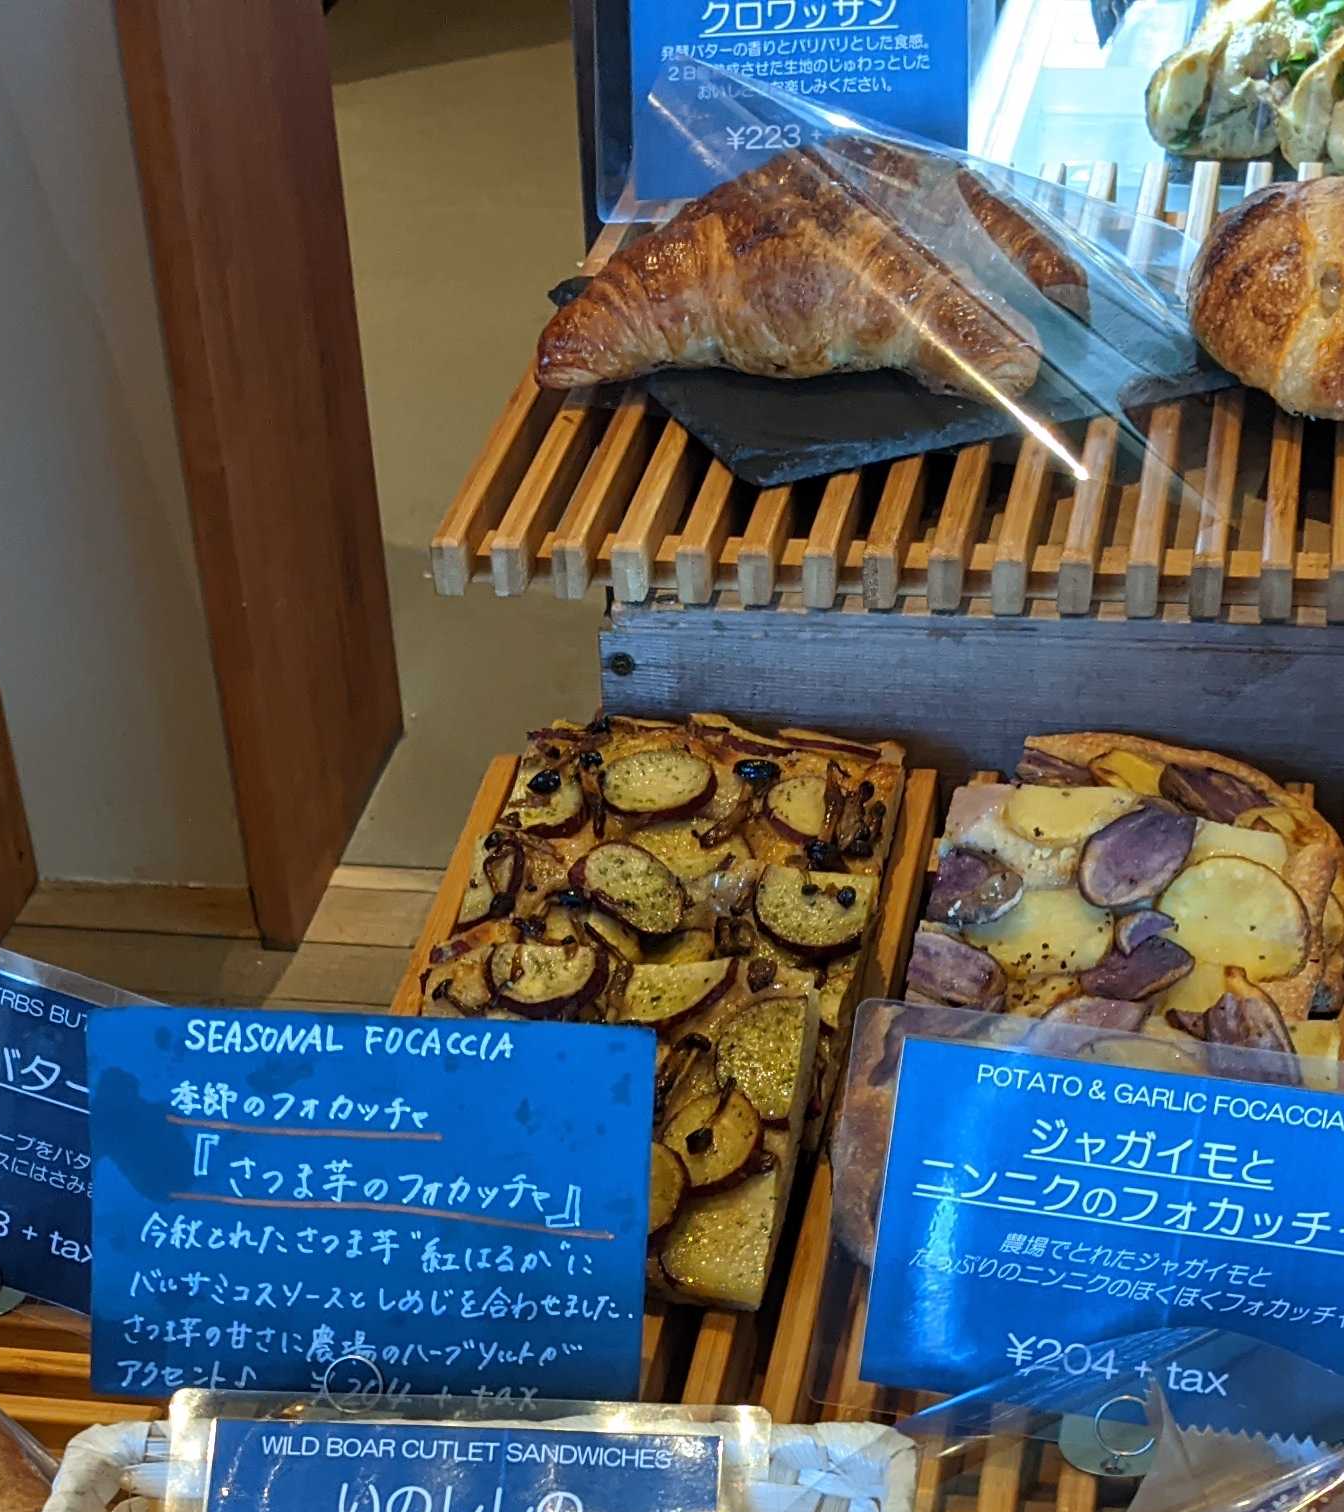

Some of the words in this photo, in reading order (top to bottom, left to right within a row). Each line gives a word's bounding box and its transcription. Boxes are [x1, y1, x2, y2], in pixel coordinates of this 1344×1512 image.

[726, 124, 801, 150] ¥223
[184, 1019, 344, 1053] SEASONAL
[364, 1025, 516, 1061] FOCACCIA
[169, 1079, 430, 1130] 季節のフォカッチャ
[976, 1061, 1083, 1100] POTATO
[1088, 1080, 1108, 1101] &
[1113, 1081, 1209, 1115] GARLIC
[1029, 1116, 1276, 1186] ジャガイモと
[998, 1231, 1273, 1289] 農場でとれたジャガイモと
[1006, 1332, 1119, 1381] ¥204
[1166, 1361, 1230, 1396] tax
[261, 1433, 320, 1458] WILD
[326, 1436, 396, 1459] BOAR
[402, 1439, 498, 1464] CUTLET
[505, 1441, 674, 1470] SANDWICHES
